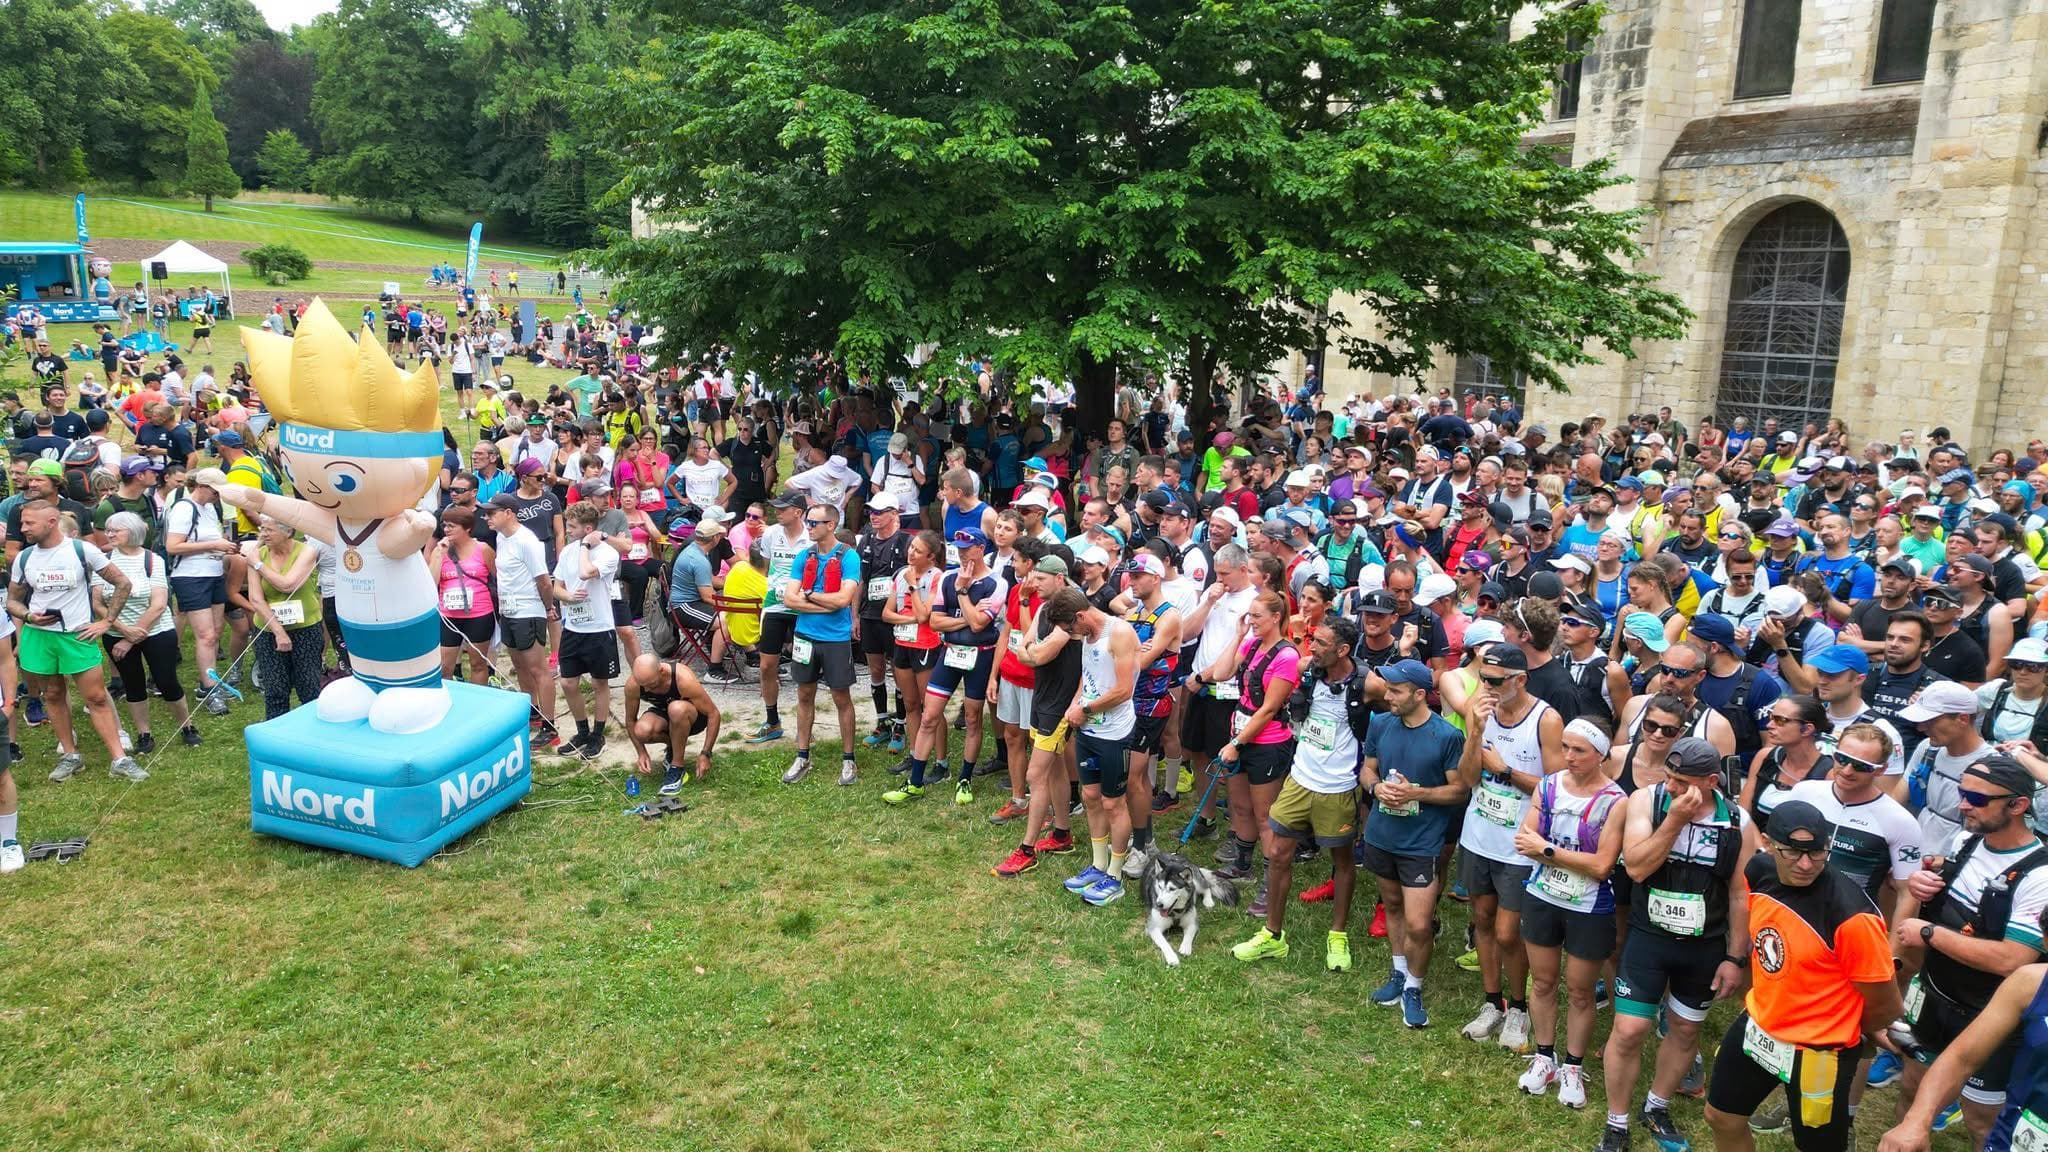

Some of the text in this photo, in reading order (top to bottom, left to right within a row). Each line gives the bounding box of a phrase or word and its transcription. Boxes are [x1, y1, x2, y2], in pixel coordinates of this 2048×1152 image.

[76, 198, 89, 238] Nord
[53, 308, 74, 316] Nord
[285, 424, 335, 449] Nord
[440, 734, 524, 818] Nord
[262, 769, 377, 828] Nord
[1487, 798, 1502, 810] 415
[1551, 868, 1570, 883] 403
[1665, 904, 1687, 918] 346
[1758, 1033, 1776, 1053] 250
